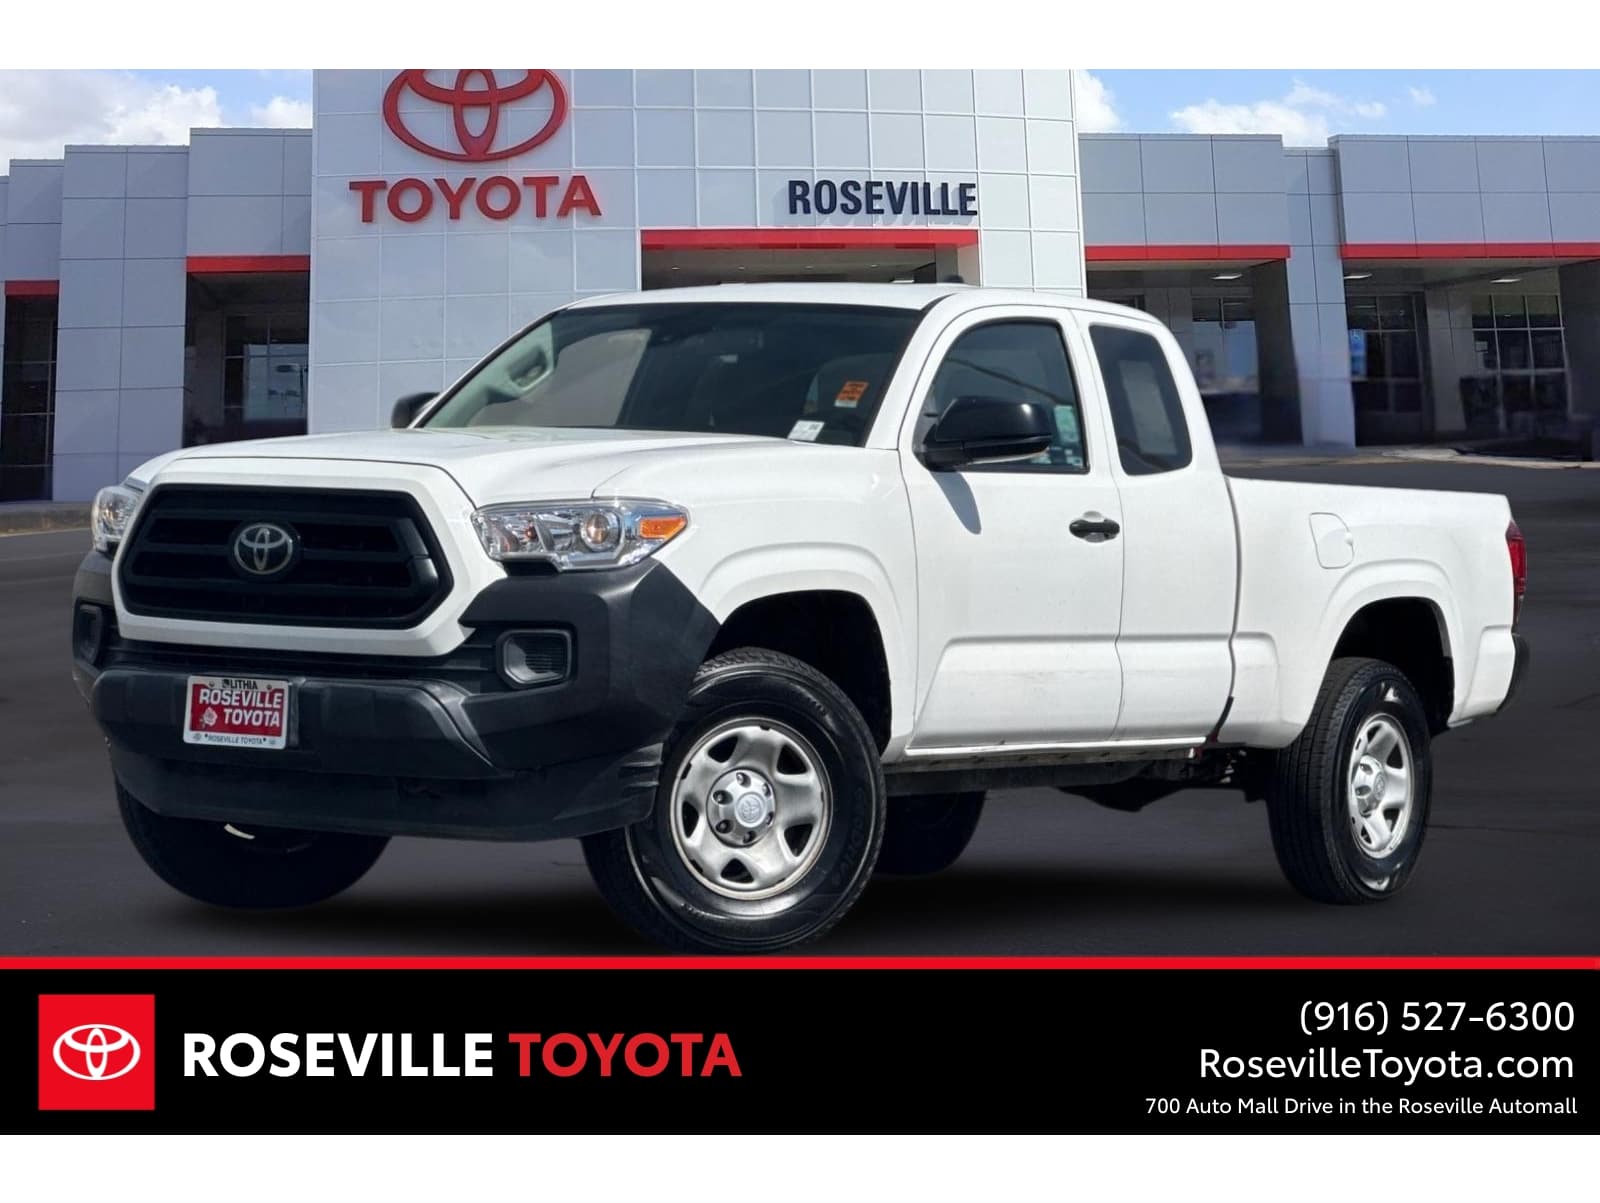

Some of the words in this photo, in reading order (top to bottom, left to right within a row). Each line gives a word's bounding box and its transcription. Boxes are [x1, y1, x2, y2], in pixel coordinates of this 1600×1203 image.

[349, 175, 602, 223] TOYOTA
[788, 179, 978, 216] ROSEVILLE
[230, 679, 258, 690] LITHIA
[199, 688, 283, 709] ROSEVILLE
[223, 708, 281, 727] TOYOTA
